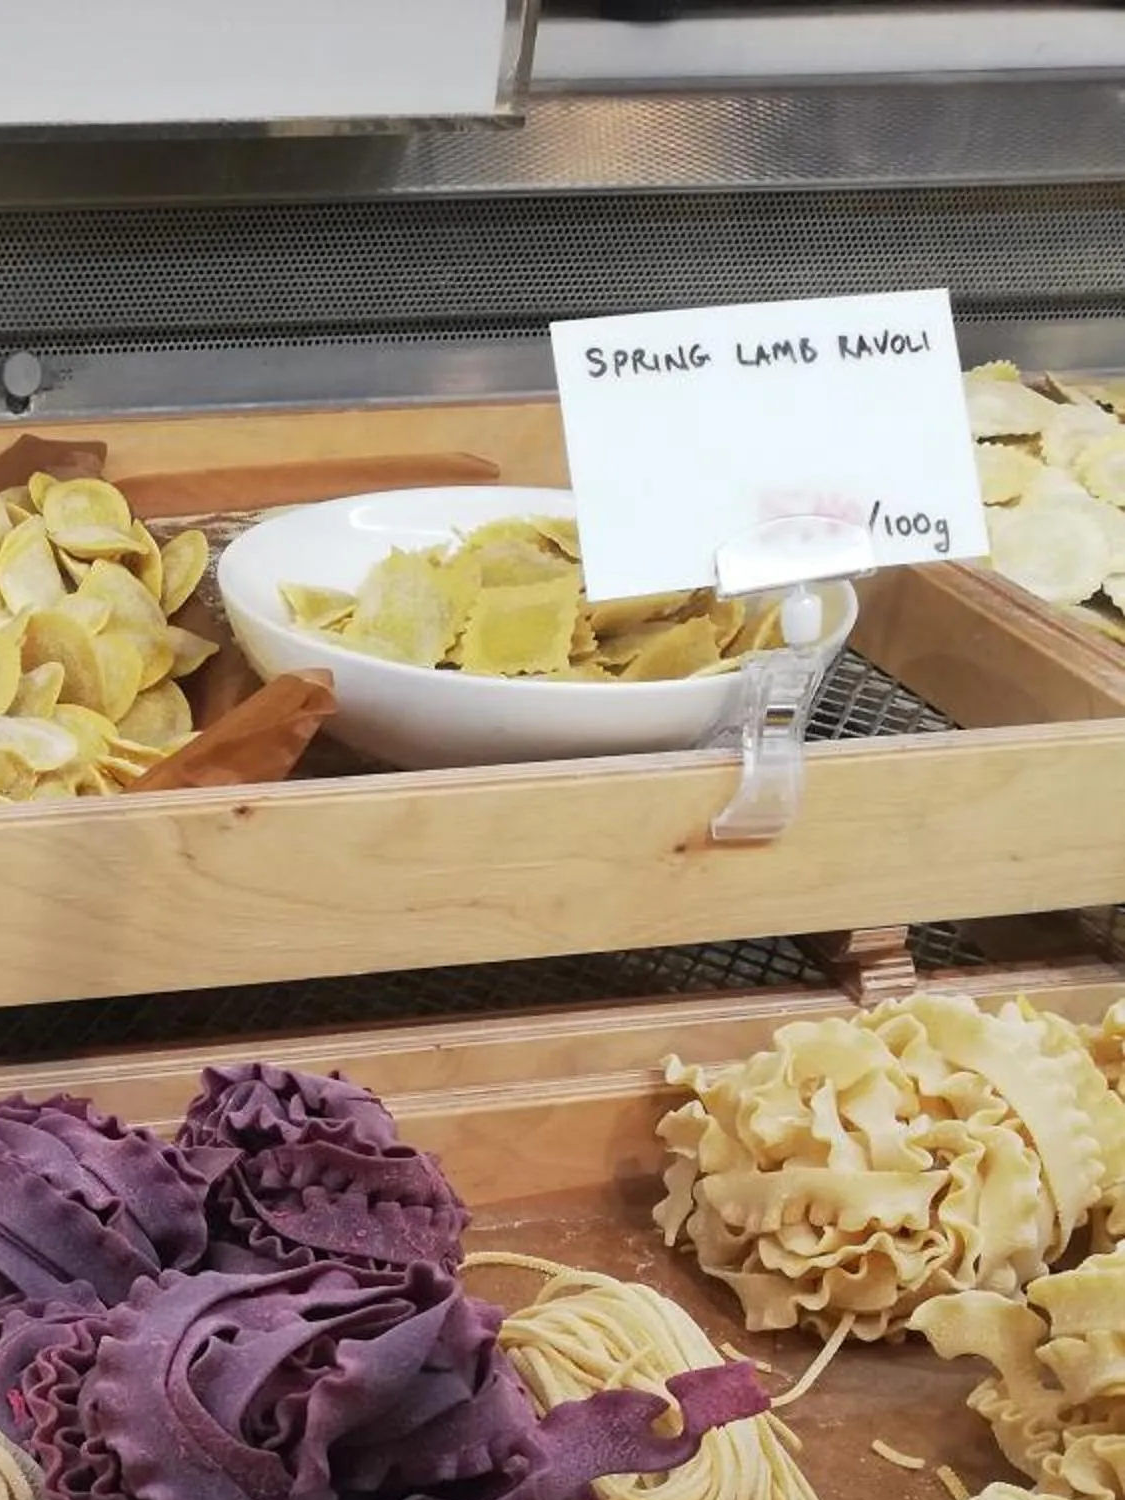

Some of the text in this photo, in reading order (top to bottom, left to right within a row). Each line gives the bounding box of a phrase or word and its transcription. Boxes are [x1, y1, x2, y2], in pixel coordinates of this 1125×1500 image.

[585, 329, 932, 379] SPRING LAMB RAVOLI
[869, 499, 950, 553] /100g
